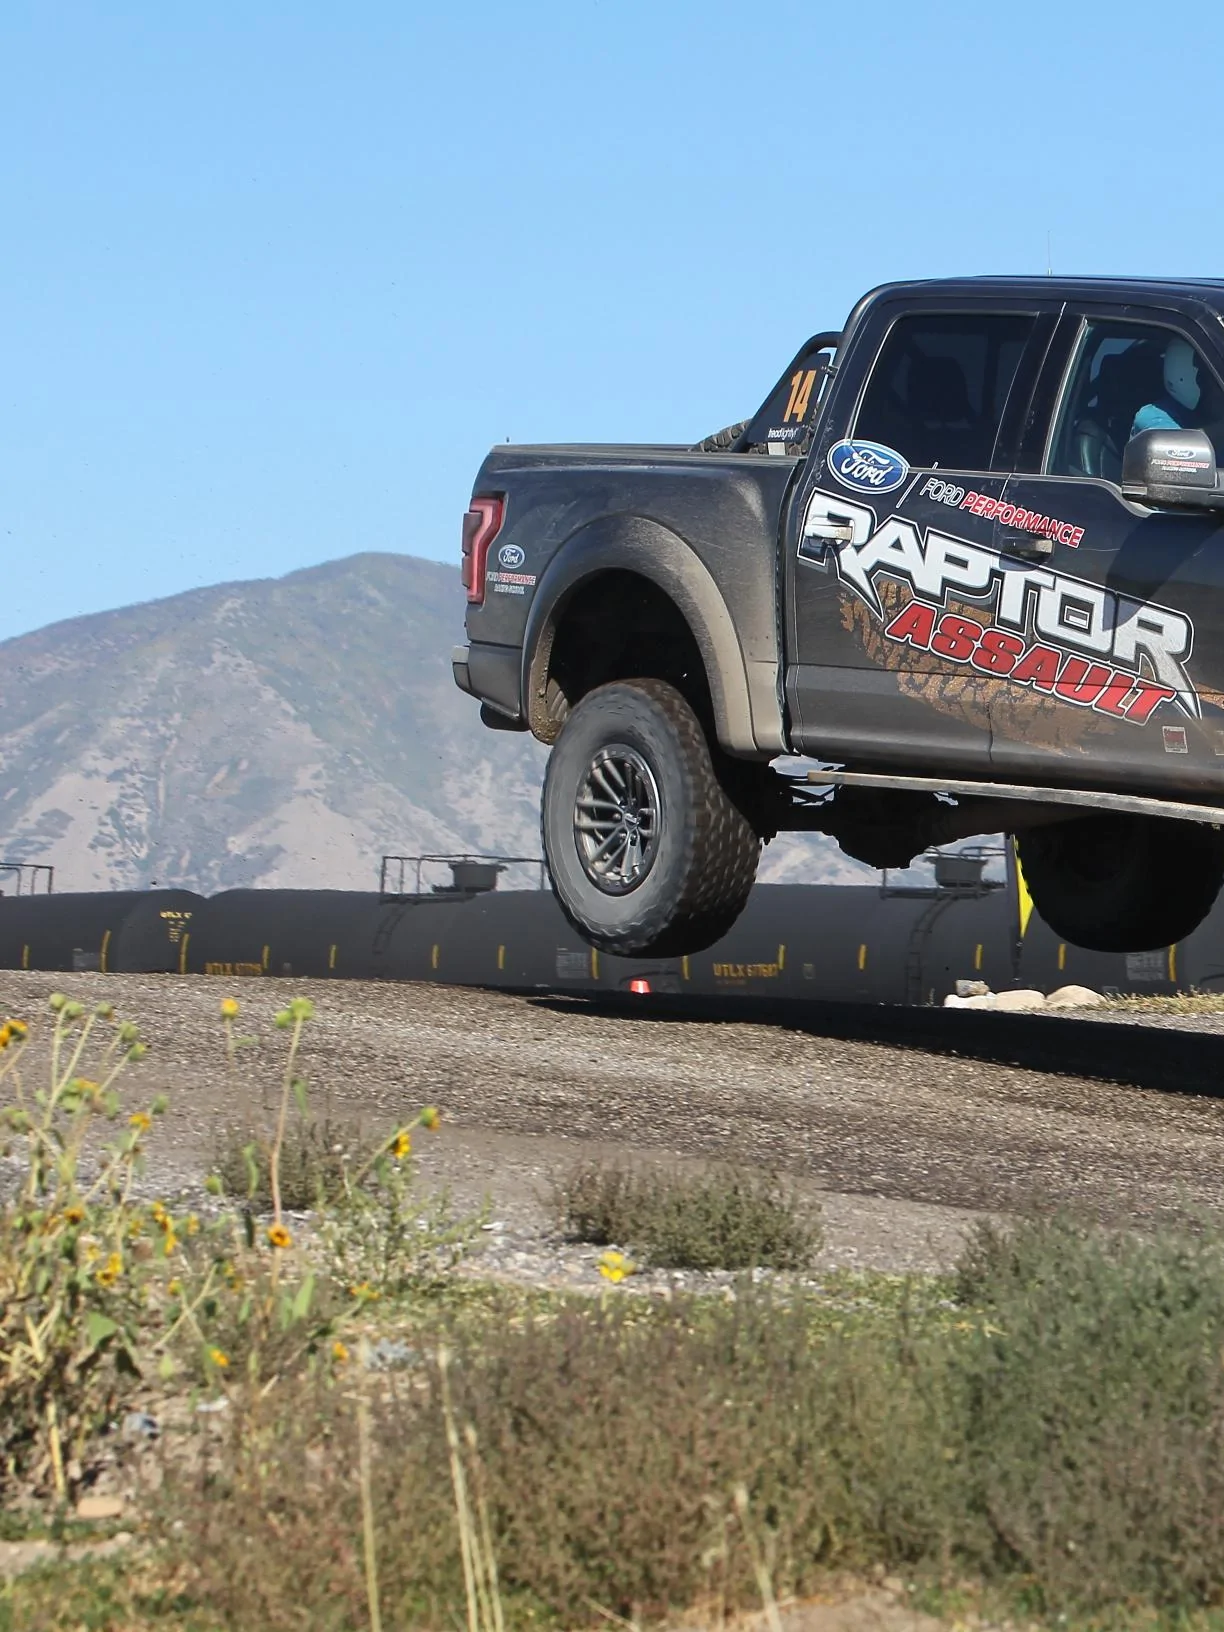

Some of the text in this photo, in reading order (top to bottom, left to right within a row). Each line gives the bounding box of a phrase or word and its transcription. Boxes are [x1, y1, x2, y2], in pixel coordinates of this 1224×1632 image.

[783, 370, 817, 422] 14
[840, 448, 894, 486] Ford
[919, 477, 1086, 549] FORD PERFORMANCE
[798, 467, 1203, 721] RAPTOR
[884, 600, 1177, 727] ASSAULT
